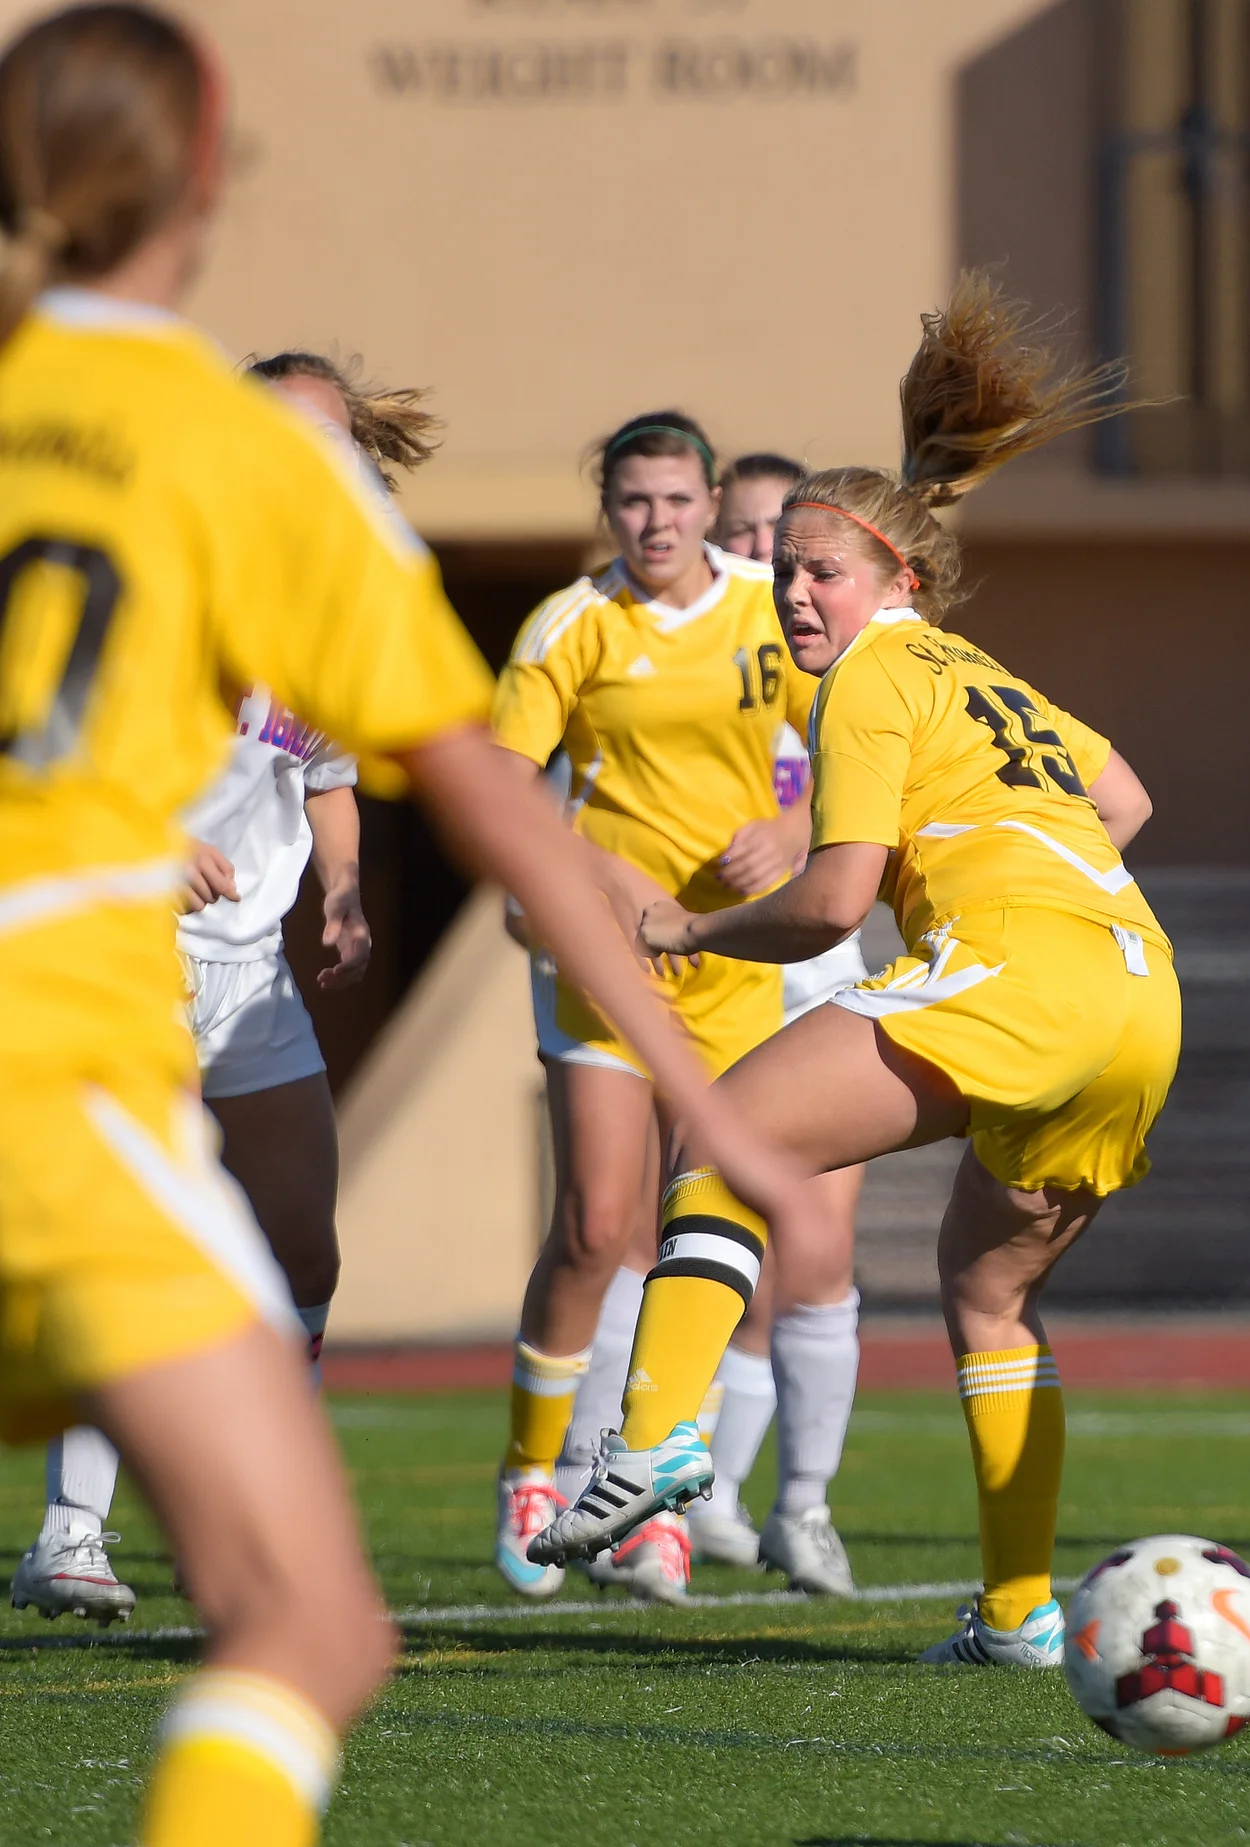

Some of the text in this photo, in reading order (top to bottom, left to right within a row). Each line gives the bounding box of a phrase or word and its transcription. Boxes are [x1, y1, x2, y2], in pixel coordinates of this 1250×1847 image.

[653, 40, 857, 98] ROOM
[733, 643, 784, 716] 16
[964, 684, 1097, 811] 15
